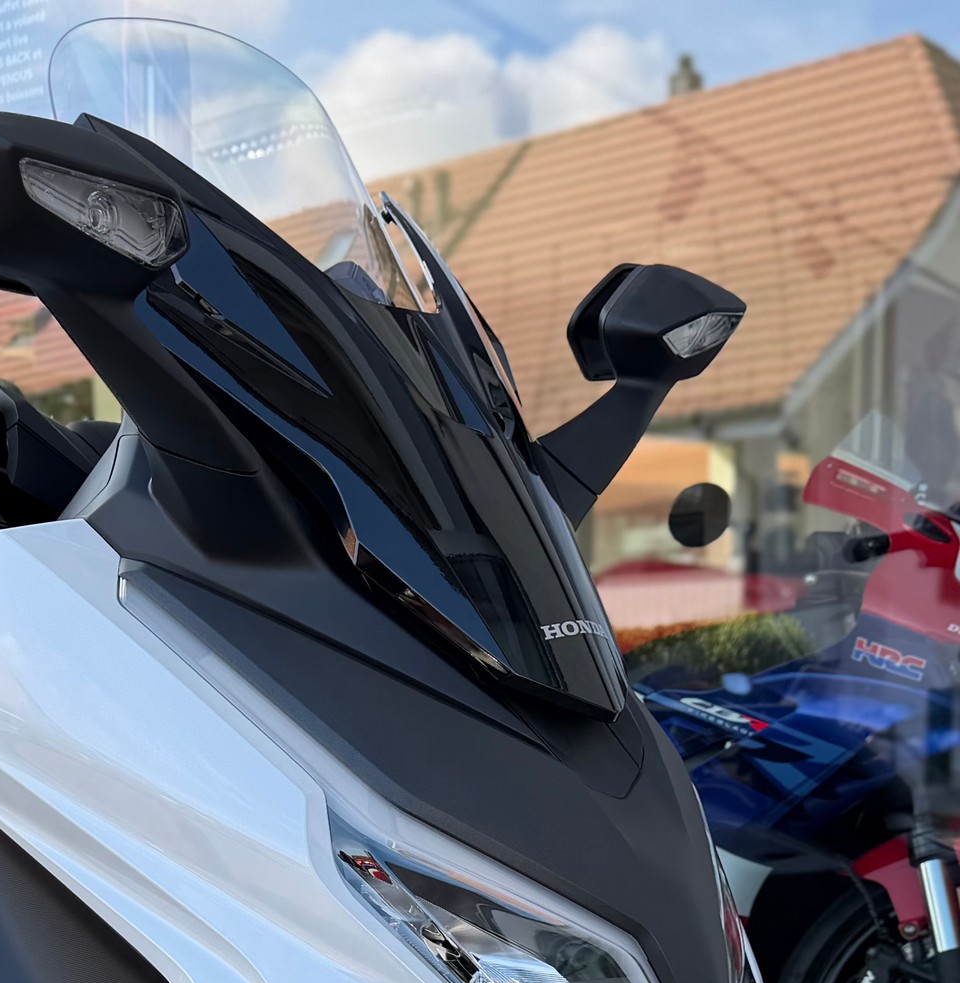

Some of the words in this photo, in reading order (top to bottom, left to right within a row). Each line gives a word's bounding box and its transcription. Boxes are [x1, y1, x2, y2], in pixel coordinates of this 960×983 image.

[540, 619, 609, 641] HONDA
[851, 636, 927, 682] HRC
[680, 697, 769, 732] CBR
